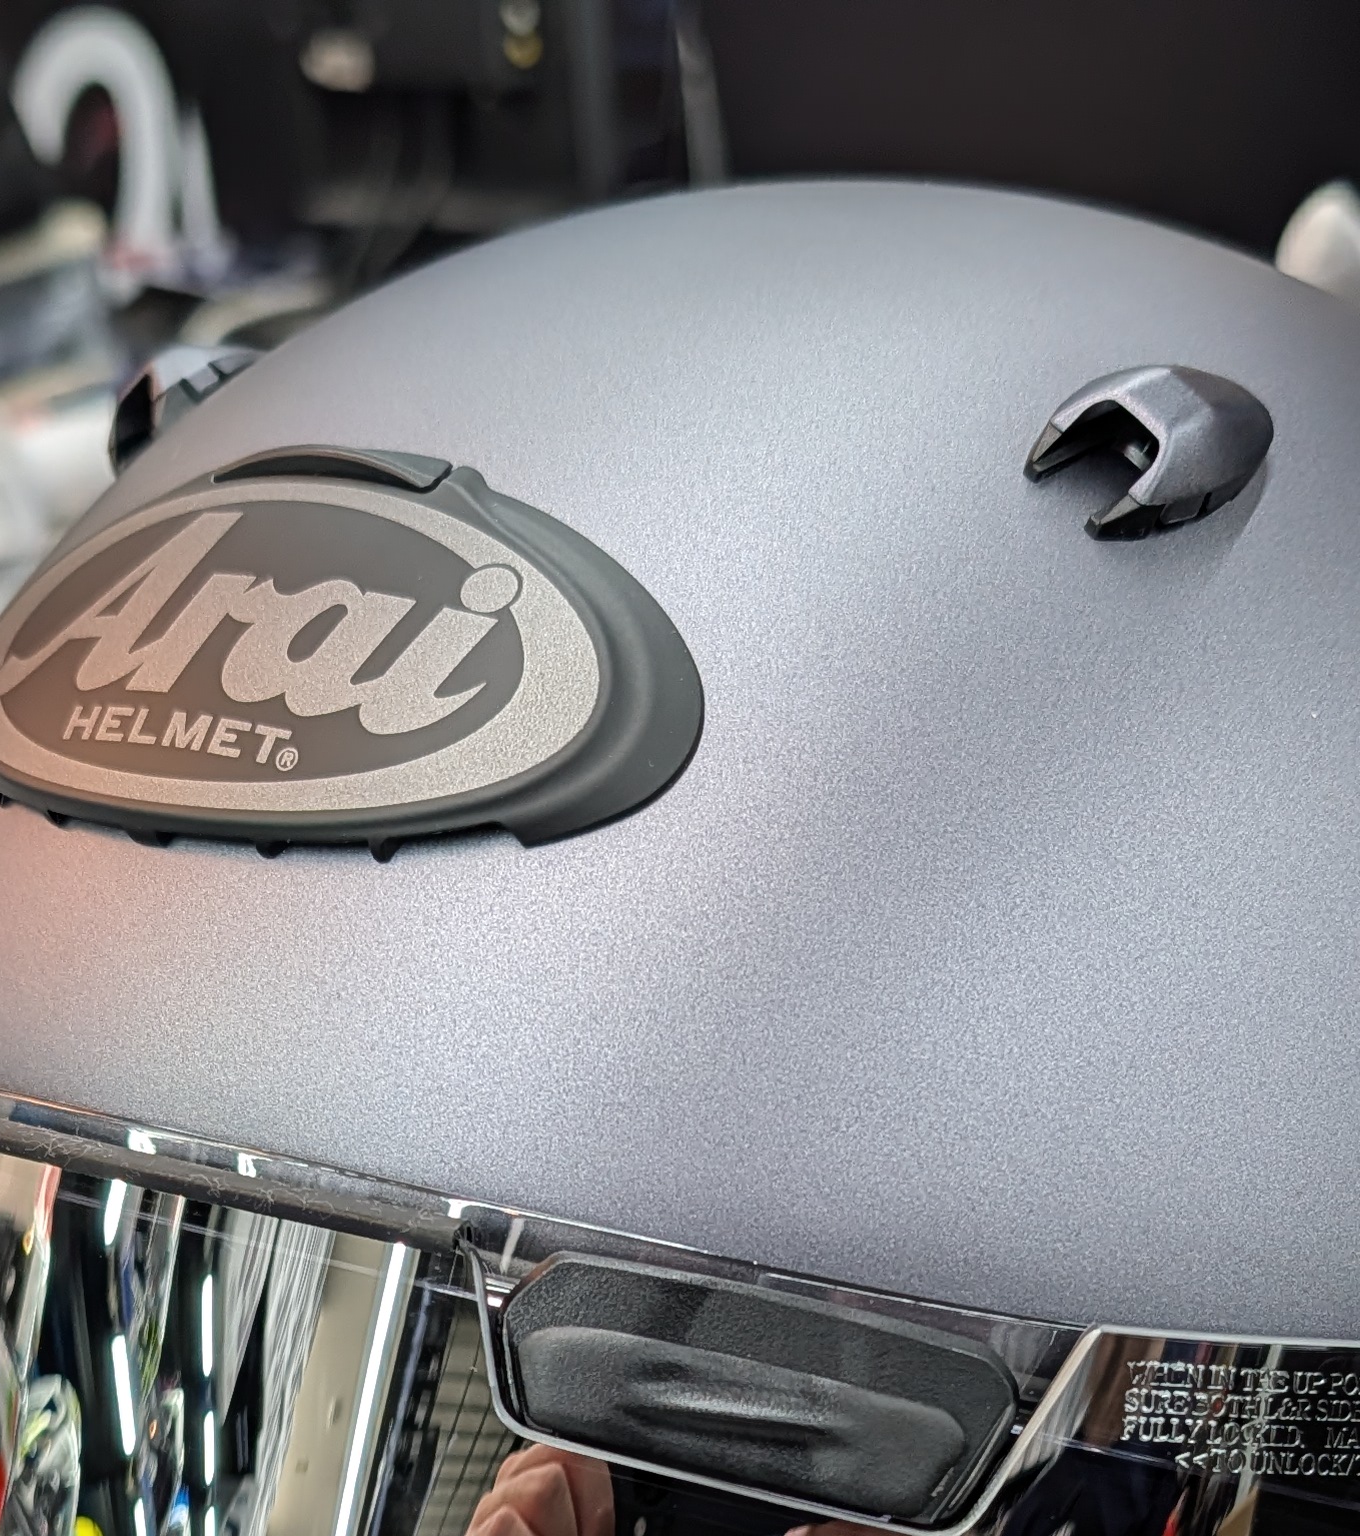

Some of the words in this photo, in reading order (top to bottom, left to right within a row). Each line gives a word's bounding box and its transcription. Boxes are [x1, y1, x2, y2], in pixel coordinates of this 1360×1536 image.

[1293, 1371, 1327, 1395] UP
[1124, 1387, 1189, 1415] SURE
[1120, 1415, 1203, 1444] FULLY
